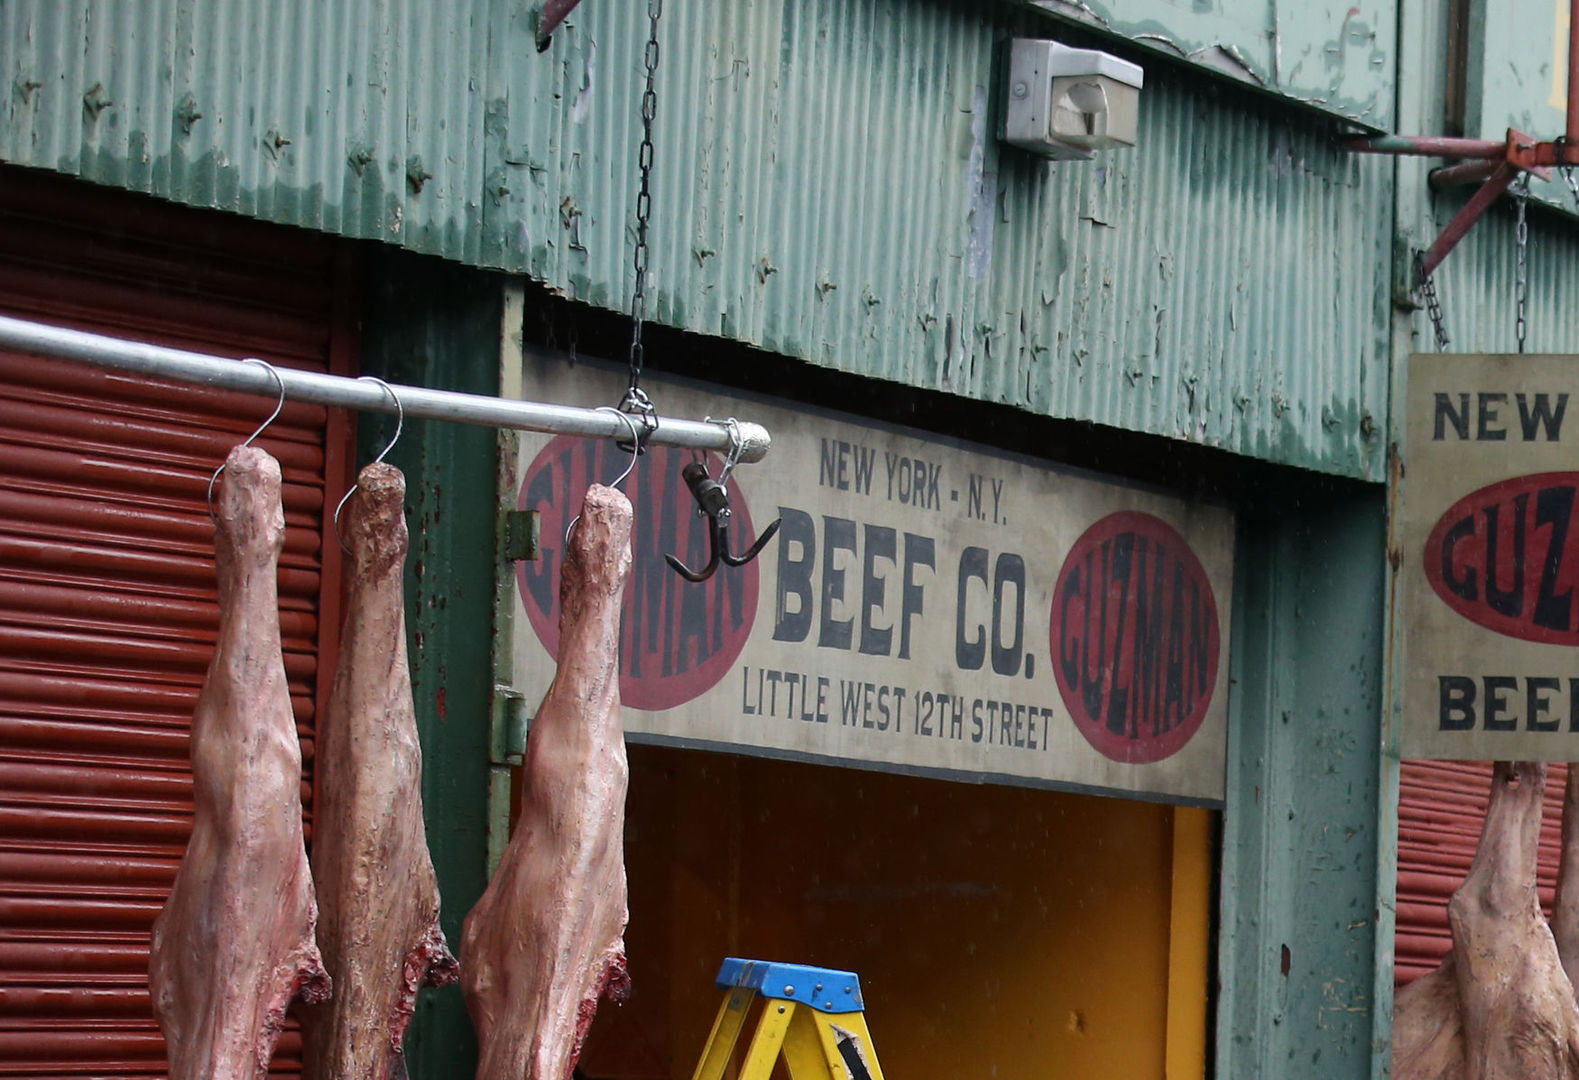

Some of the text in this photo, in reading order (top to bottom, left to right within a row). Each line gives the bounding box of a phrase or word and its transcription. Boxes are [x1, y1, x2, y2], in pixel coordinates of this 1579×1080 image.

[1433, 392, 1569, 442] NEW
[819, 437, 877, 495] NEW
[884, 450, 942, 512] YORK
[966, 475, 1007, 527] N.Y.
[773, 506, 1036, 679] BEEF CO.
[1058, 532, 1209, 742] GUZMAN
[741, 666, 1053, 752] LITTLE WEST 12TH STREET
